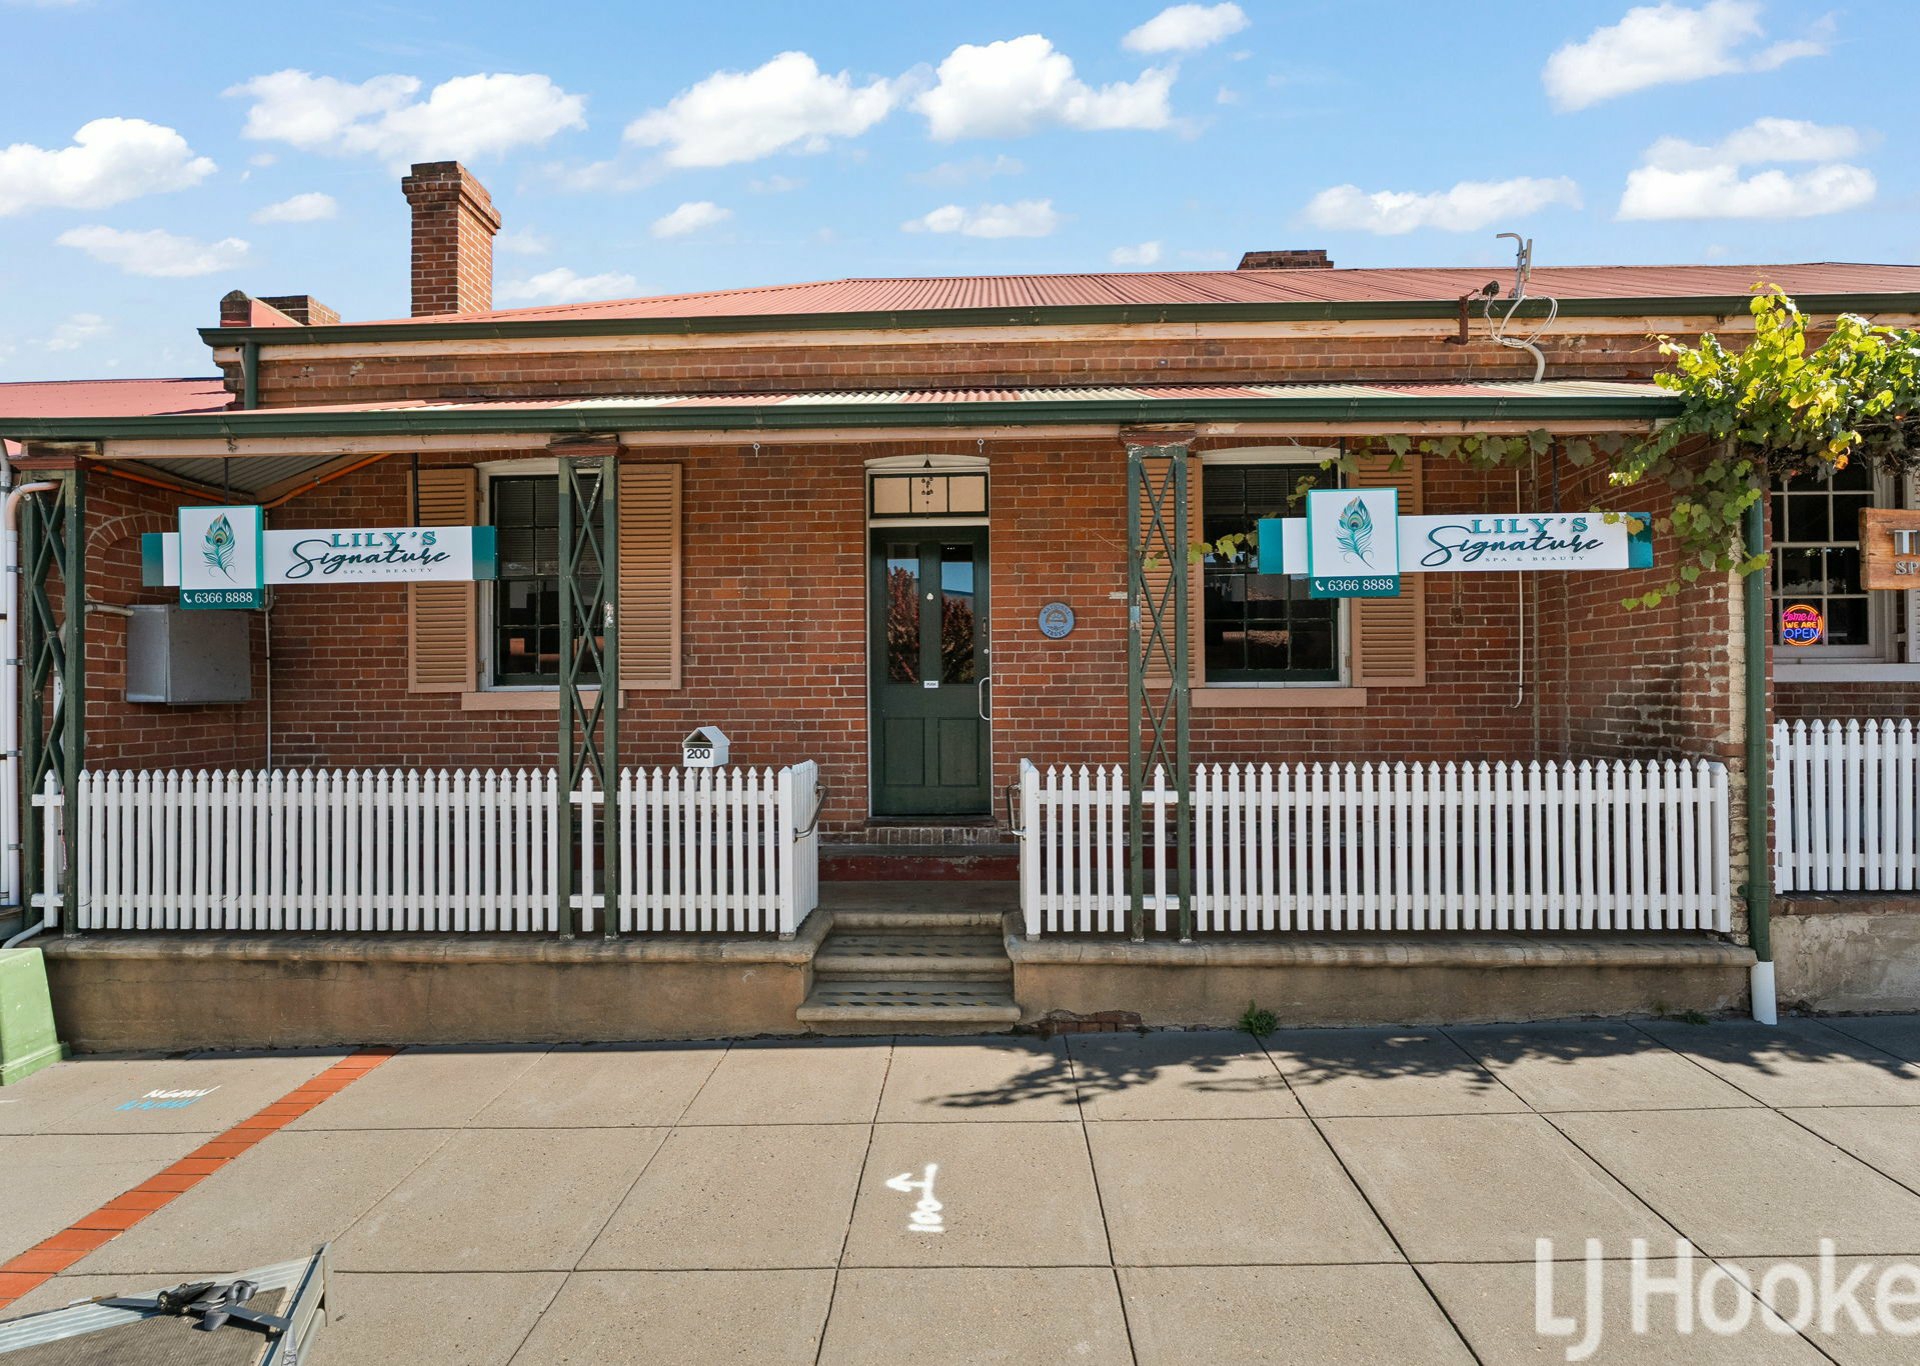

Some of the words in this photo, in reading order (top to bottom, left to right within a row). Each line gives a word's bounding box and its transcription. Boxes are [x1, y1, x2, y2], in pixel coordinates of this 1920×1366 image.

[1471, 516, 1589, 534] LILY'S
[331, 530, 438, 549] LILY'S
[1420, 525, 1604, 567] Signature
[1886, 528, 1920, 556] T
[285, 538, 451, 580] Signature
[1327, 579, 1359, 592] 6366
[1362, 578, 1394, 591] 8888
[194, 591, 223, 604] 6366
[225, 591, 253, 603] 8888
[1785, 621, 1799, 629] WE
[1801, 621, 1817, 629] ARE
[1783, 628, 1820, 639] OPEN
[686, 748, 711, 759] 200
